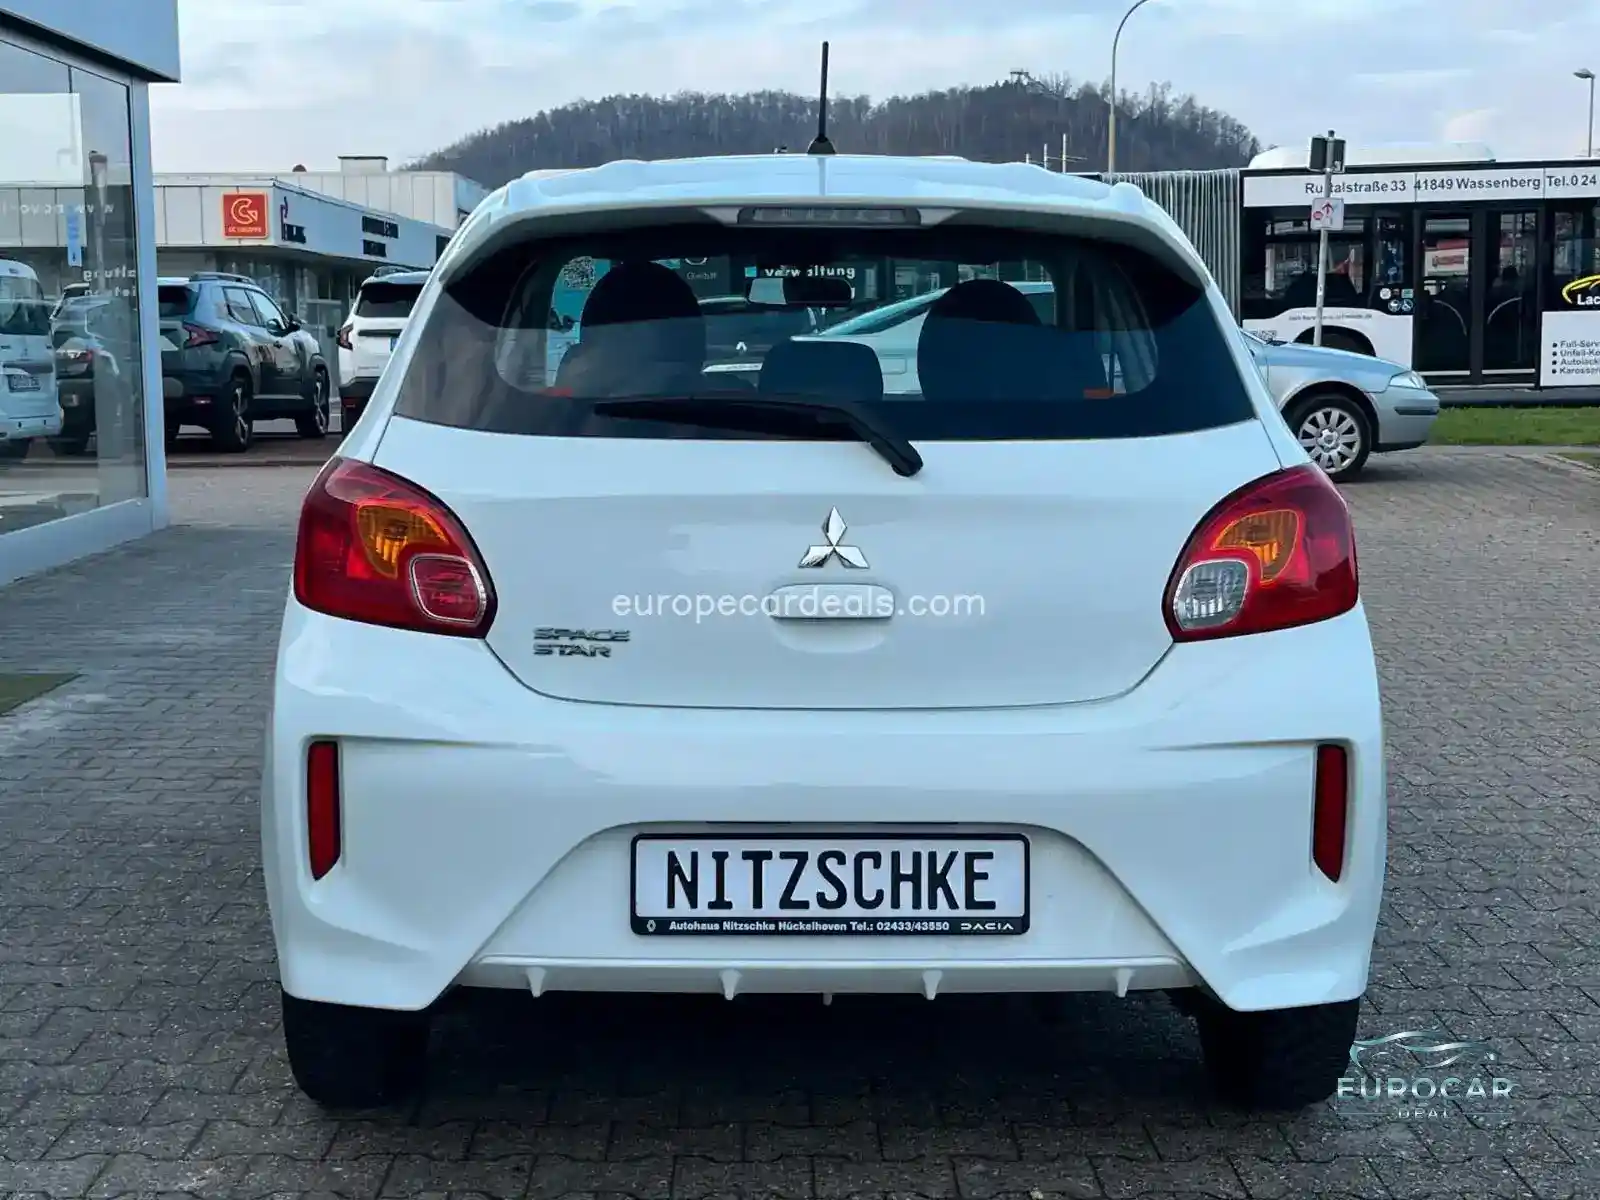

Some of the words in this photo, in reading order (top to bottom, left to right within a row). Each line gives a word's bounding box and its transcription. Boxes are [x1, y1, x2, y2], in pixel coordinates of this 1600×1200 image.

[1305, 180, 1388, 194] Rutalstraße
[1390, 180, 1407, 192] 33
[1413, 178, 1454, 190] 41849
[1456, 176, 1541, 190] Wassenberg
[1577, 293, 1600, 305] Lac
[533, 627, 630, 642] SPACE
[533, 643, 611, 658] STAR
[666, 849, 997, 910] NITZSCHKE
[669, 921, 720, 931] Autohaus
[722, 921, 776, 931] Nitzschke
[778, 920, 847, 931] Hückelhoven
[849, 921, 874, 931] Tel.:
[876, 921, 950, 932] 02433/43550
[960, 922, 1014, 931] DACIA
